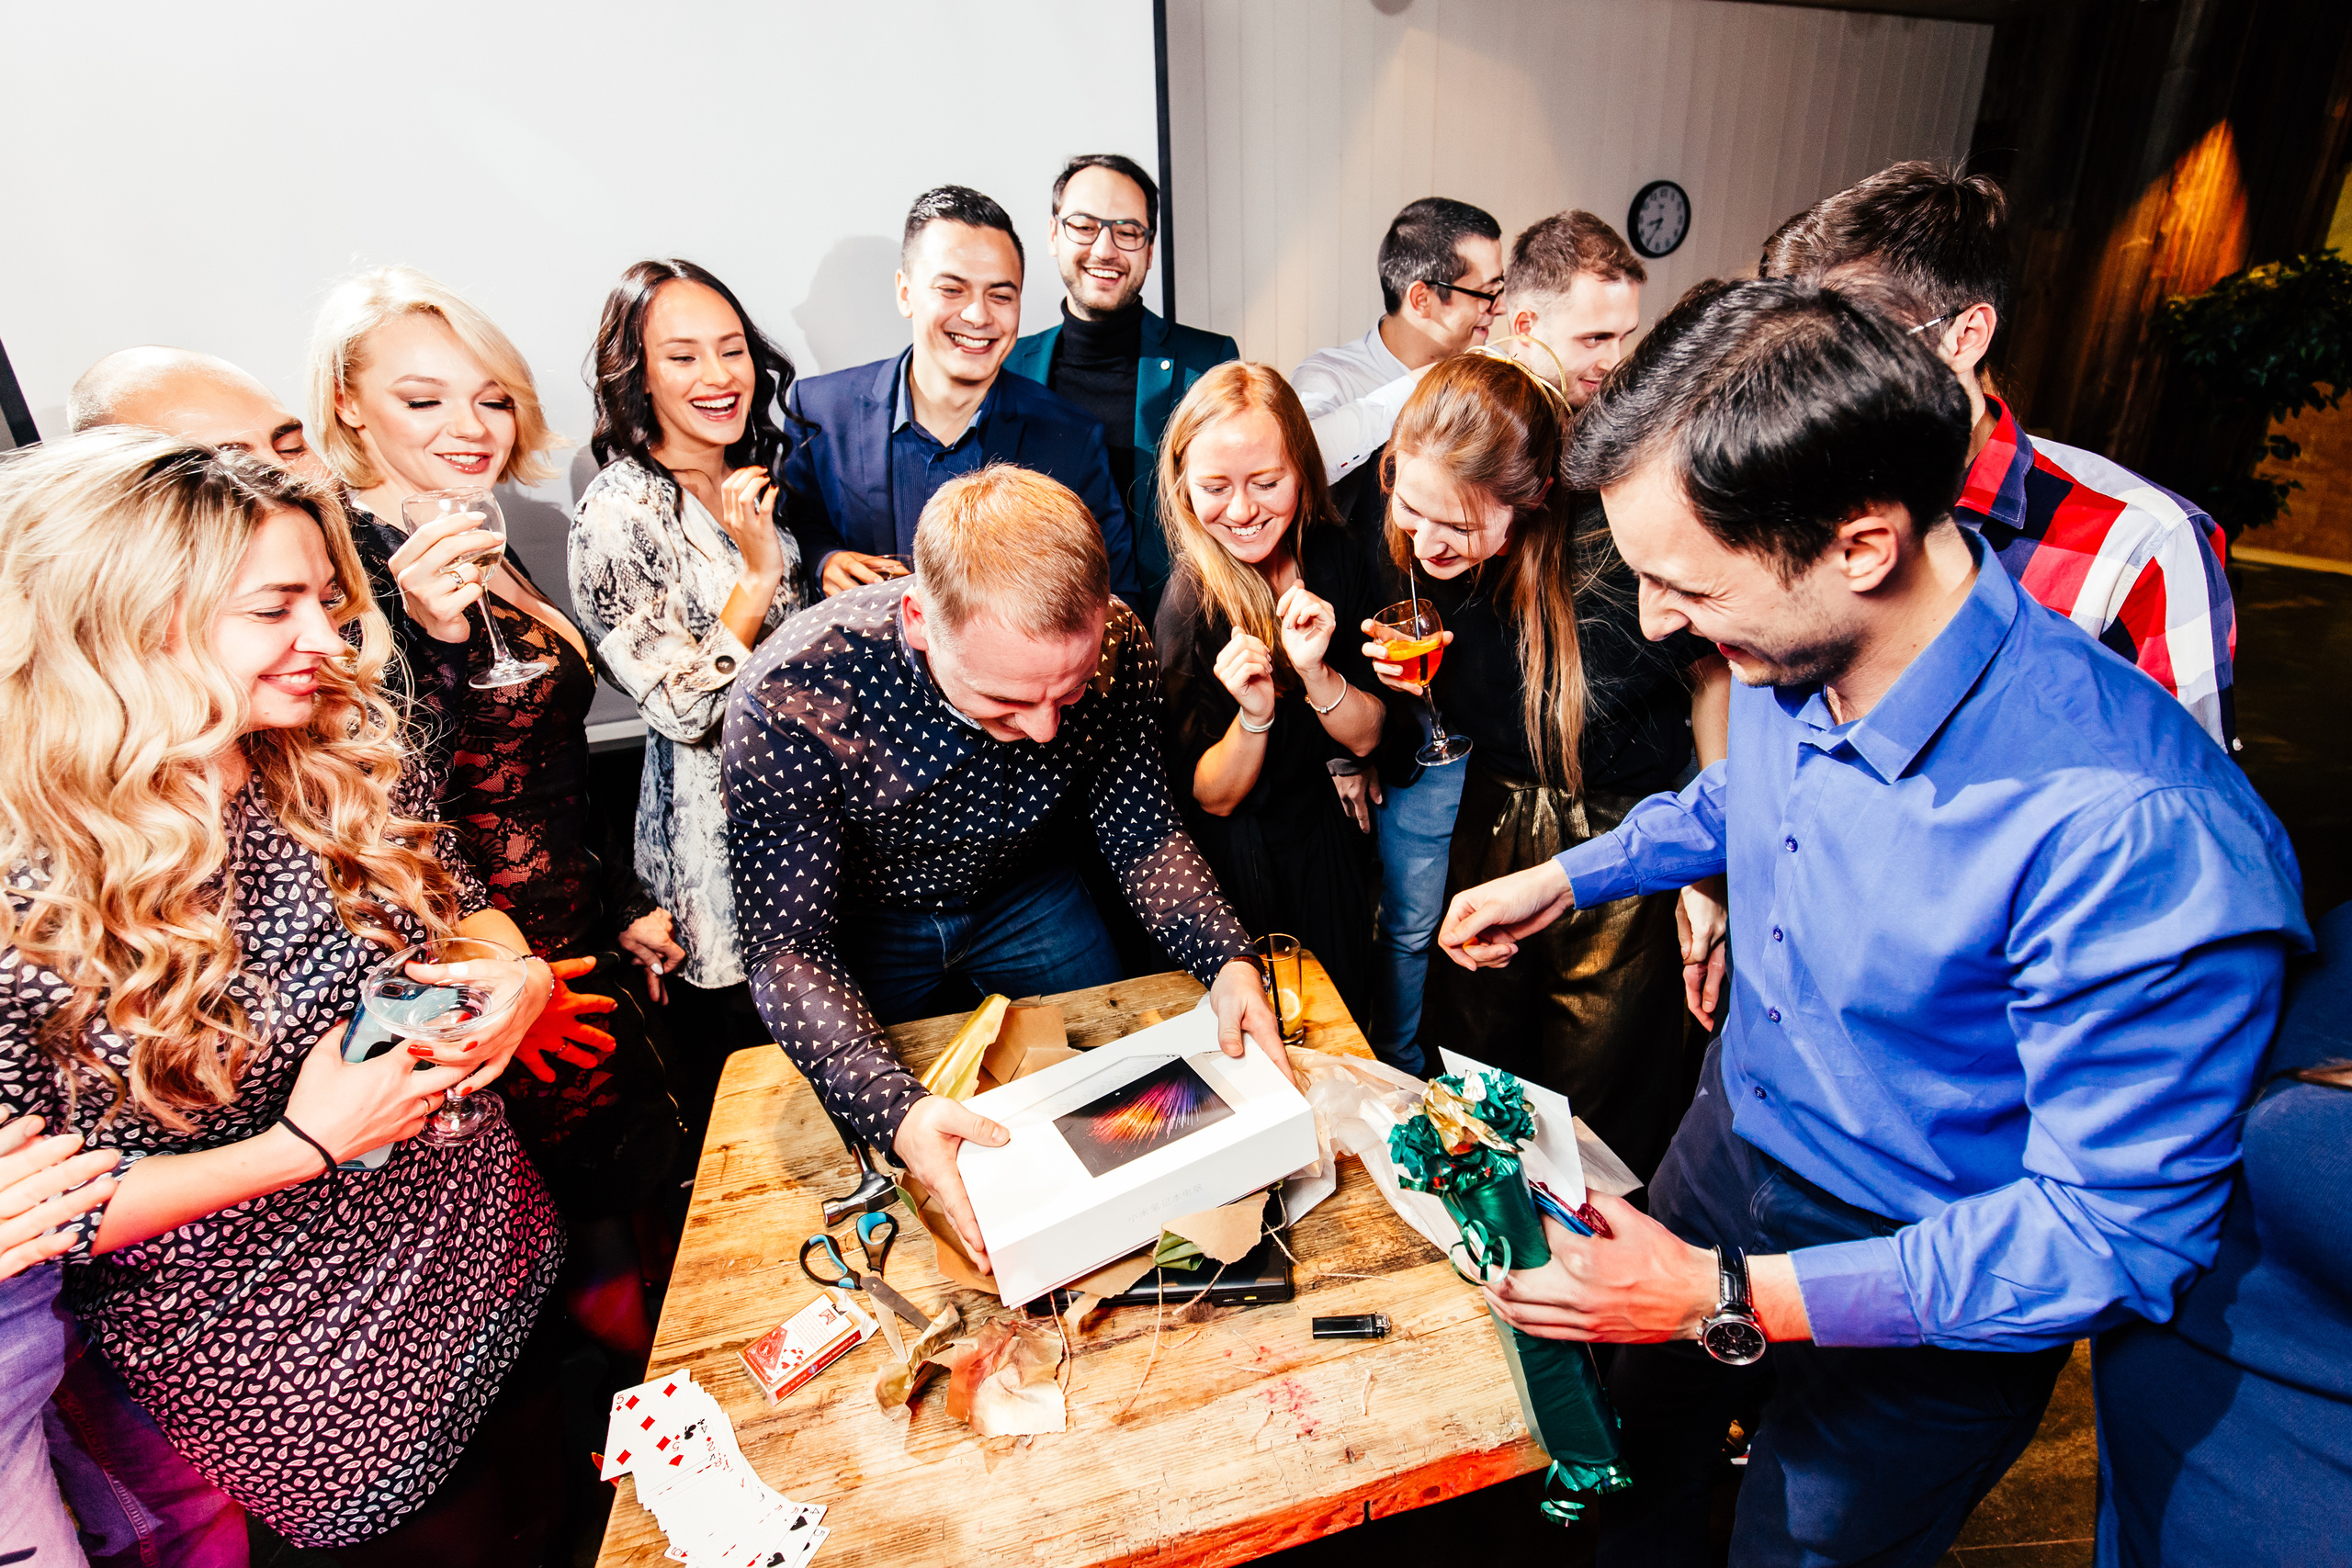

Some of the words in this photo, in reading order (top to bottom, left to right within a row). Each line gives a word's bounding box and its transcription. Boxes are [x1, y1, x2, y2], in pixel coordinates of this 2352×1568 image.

[796, 1373, 807, 1383] MADE
[781, 1385, 790, 1393] USA
[616, 1393, 625, 1404] 5
[707, 1440, 716, 1451] 2
